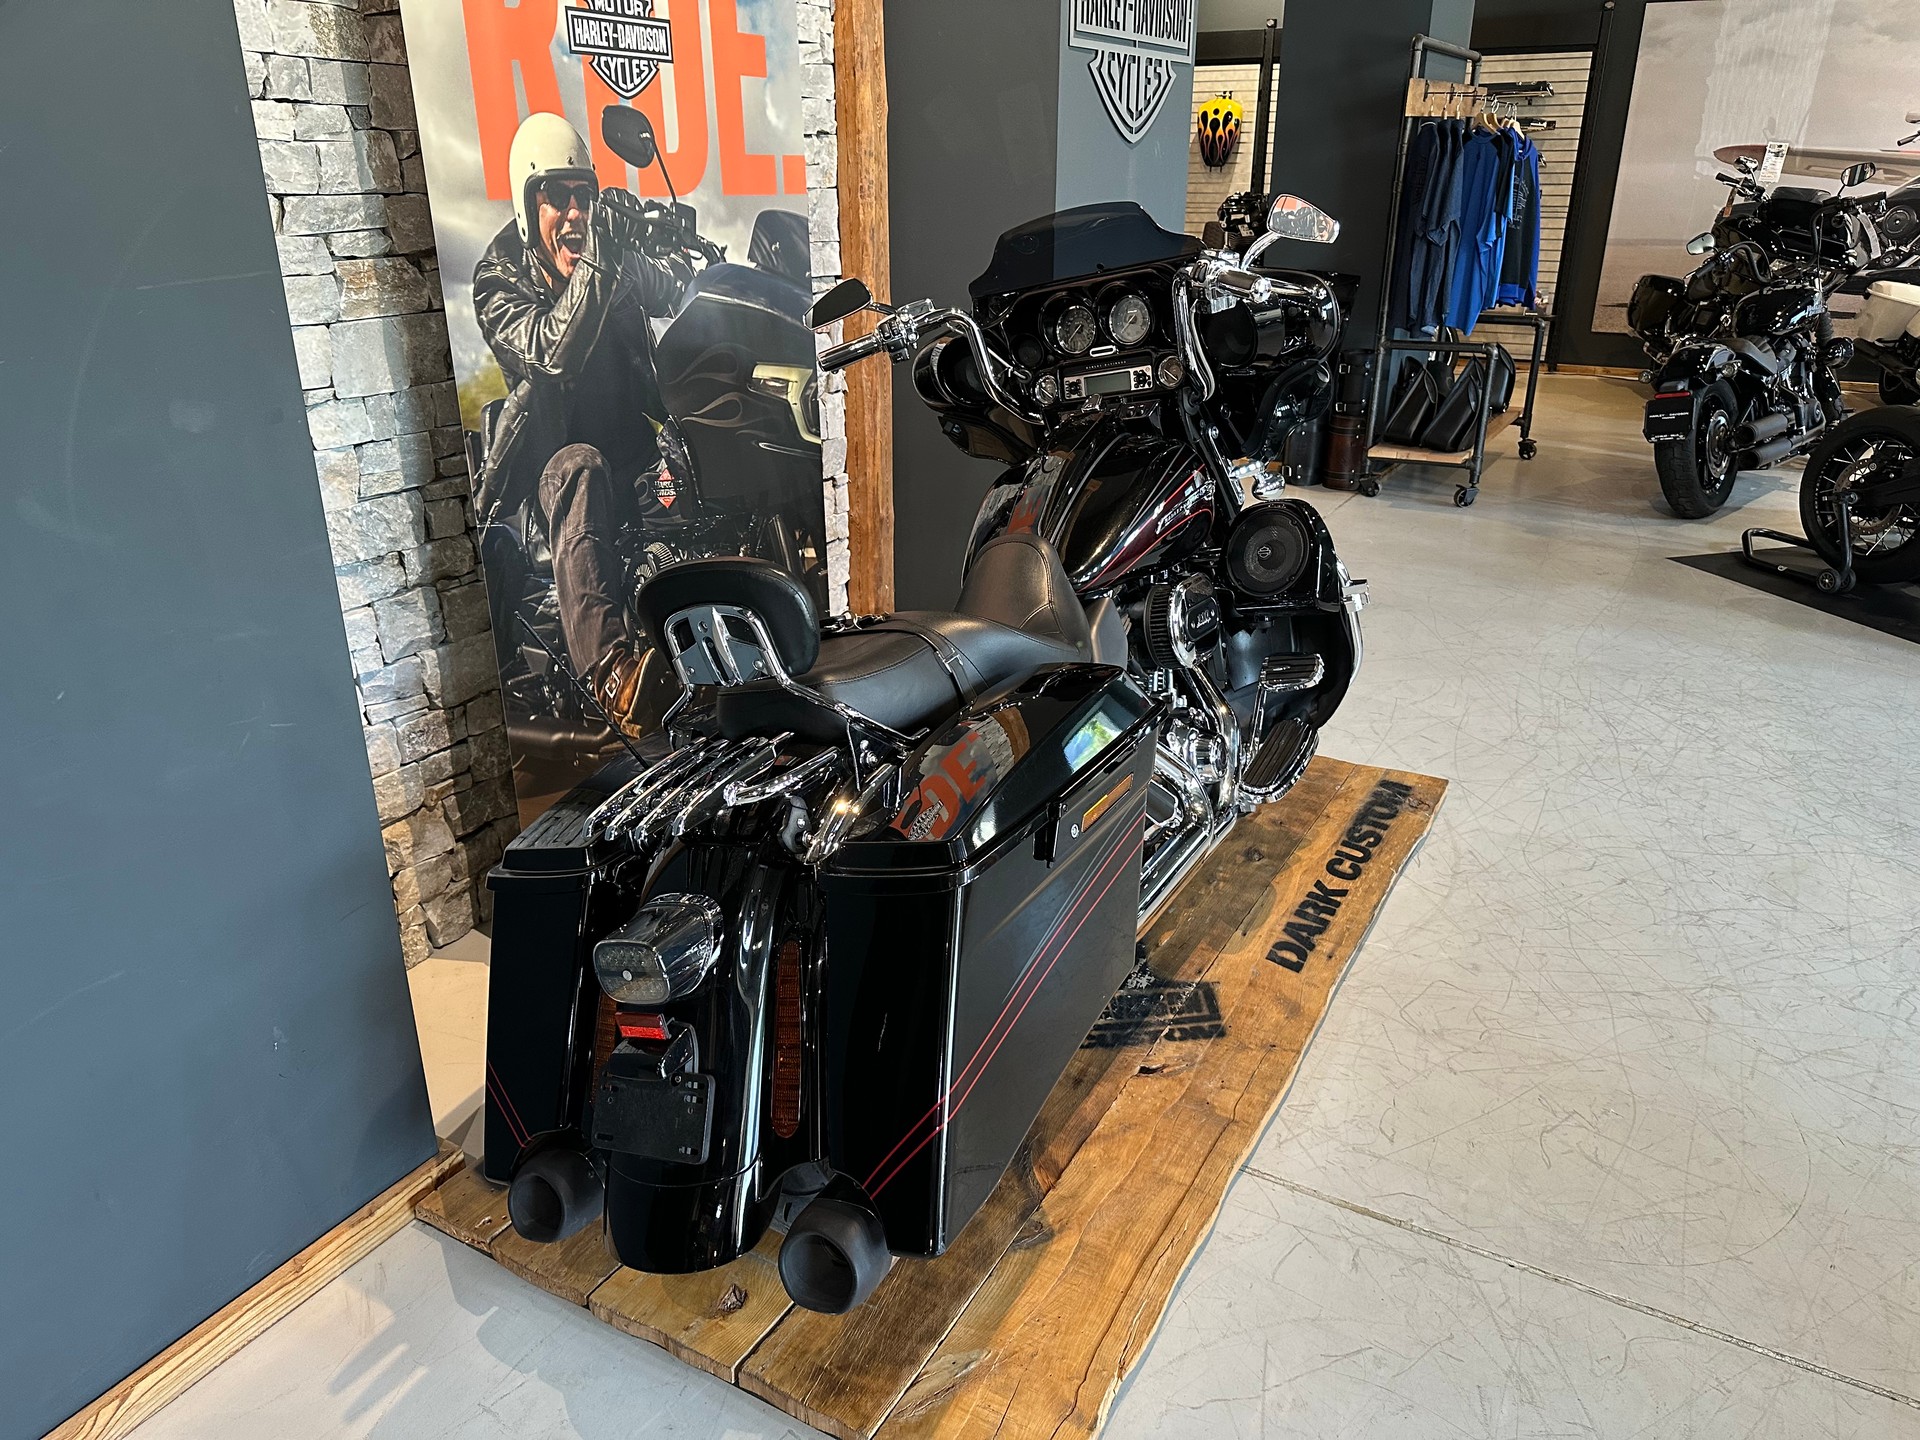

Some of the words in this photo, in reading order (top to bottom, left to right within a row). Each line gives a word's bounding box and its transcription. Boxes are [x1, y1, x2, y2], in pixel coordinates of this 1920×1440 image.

[573, 17, 668, 54] HARLEY-DAVIDSON
[600, 55, 650, 91] CYCLES
[1107, 50, 1163, 122] CYCLES
[1265, 879, 1349, 974] DARK
[1325, 779, 1413, 881] CUSTOM
